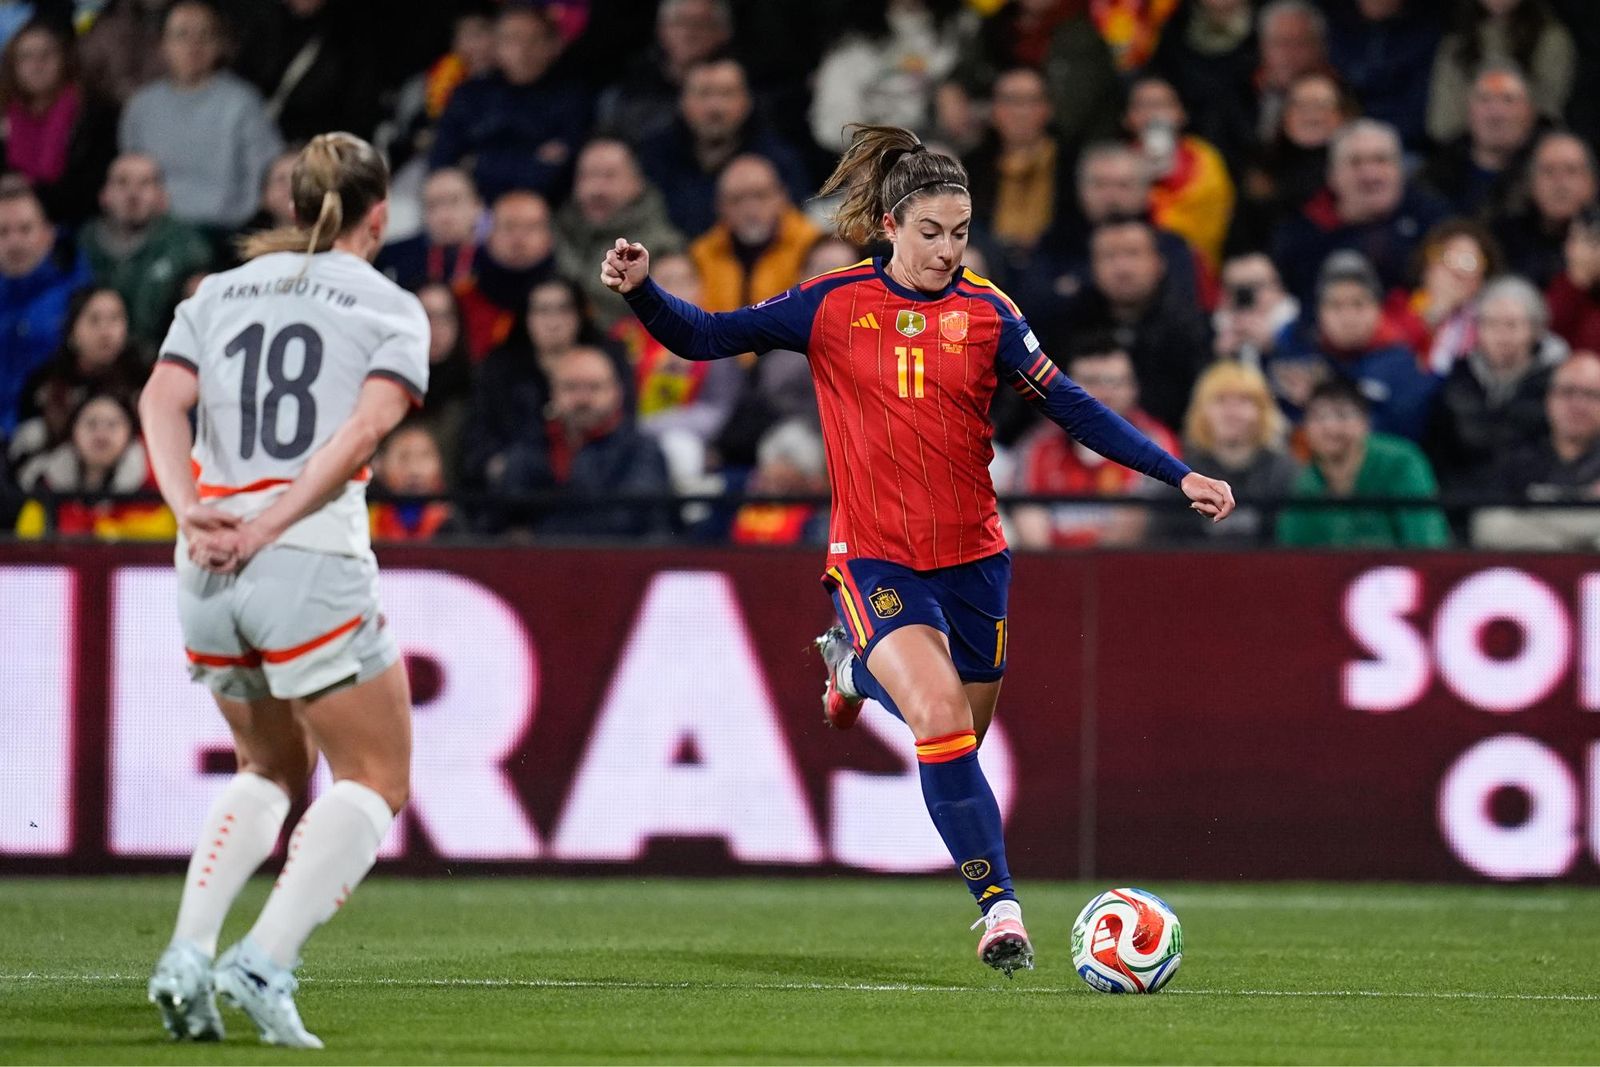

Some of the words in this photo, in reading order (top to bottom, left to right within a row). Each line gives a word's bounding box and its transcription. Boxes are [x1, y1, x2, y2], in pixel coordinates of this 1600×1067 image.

[225, 322, 324, 460] 18
[895, 346, 925, 399] 11
[1342, 564, 1600, 713] SO
